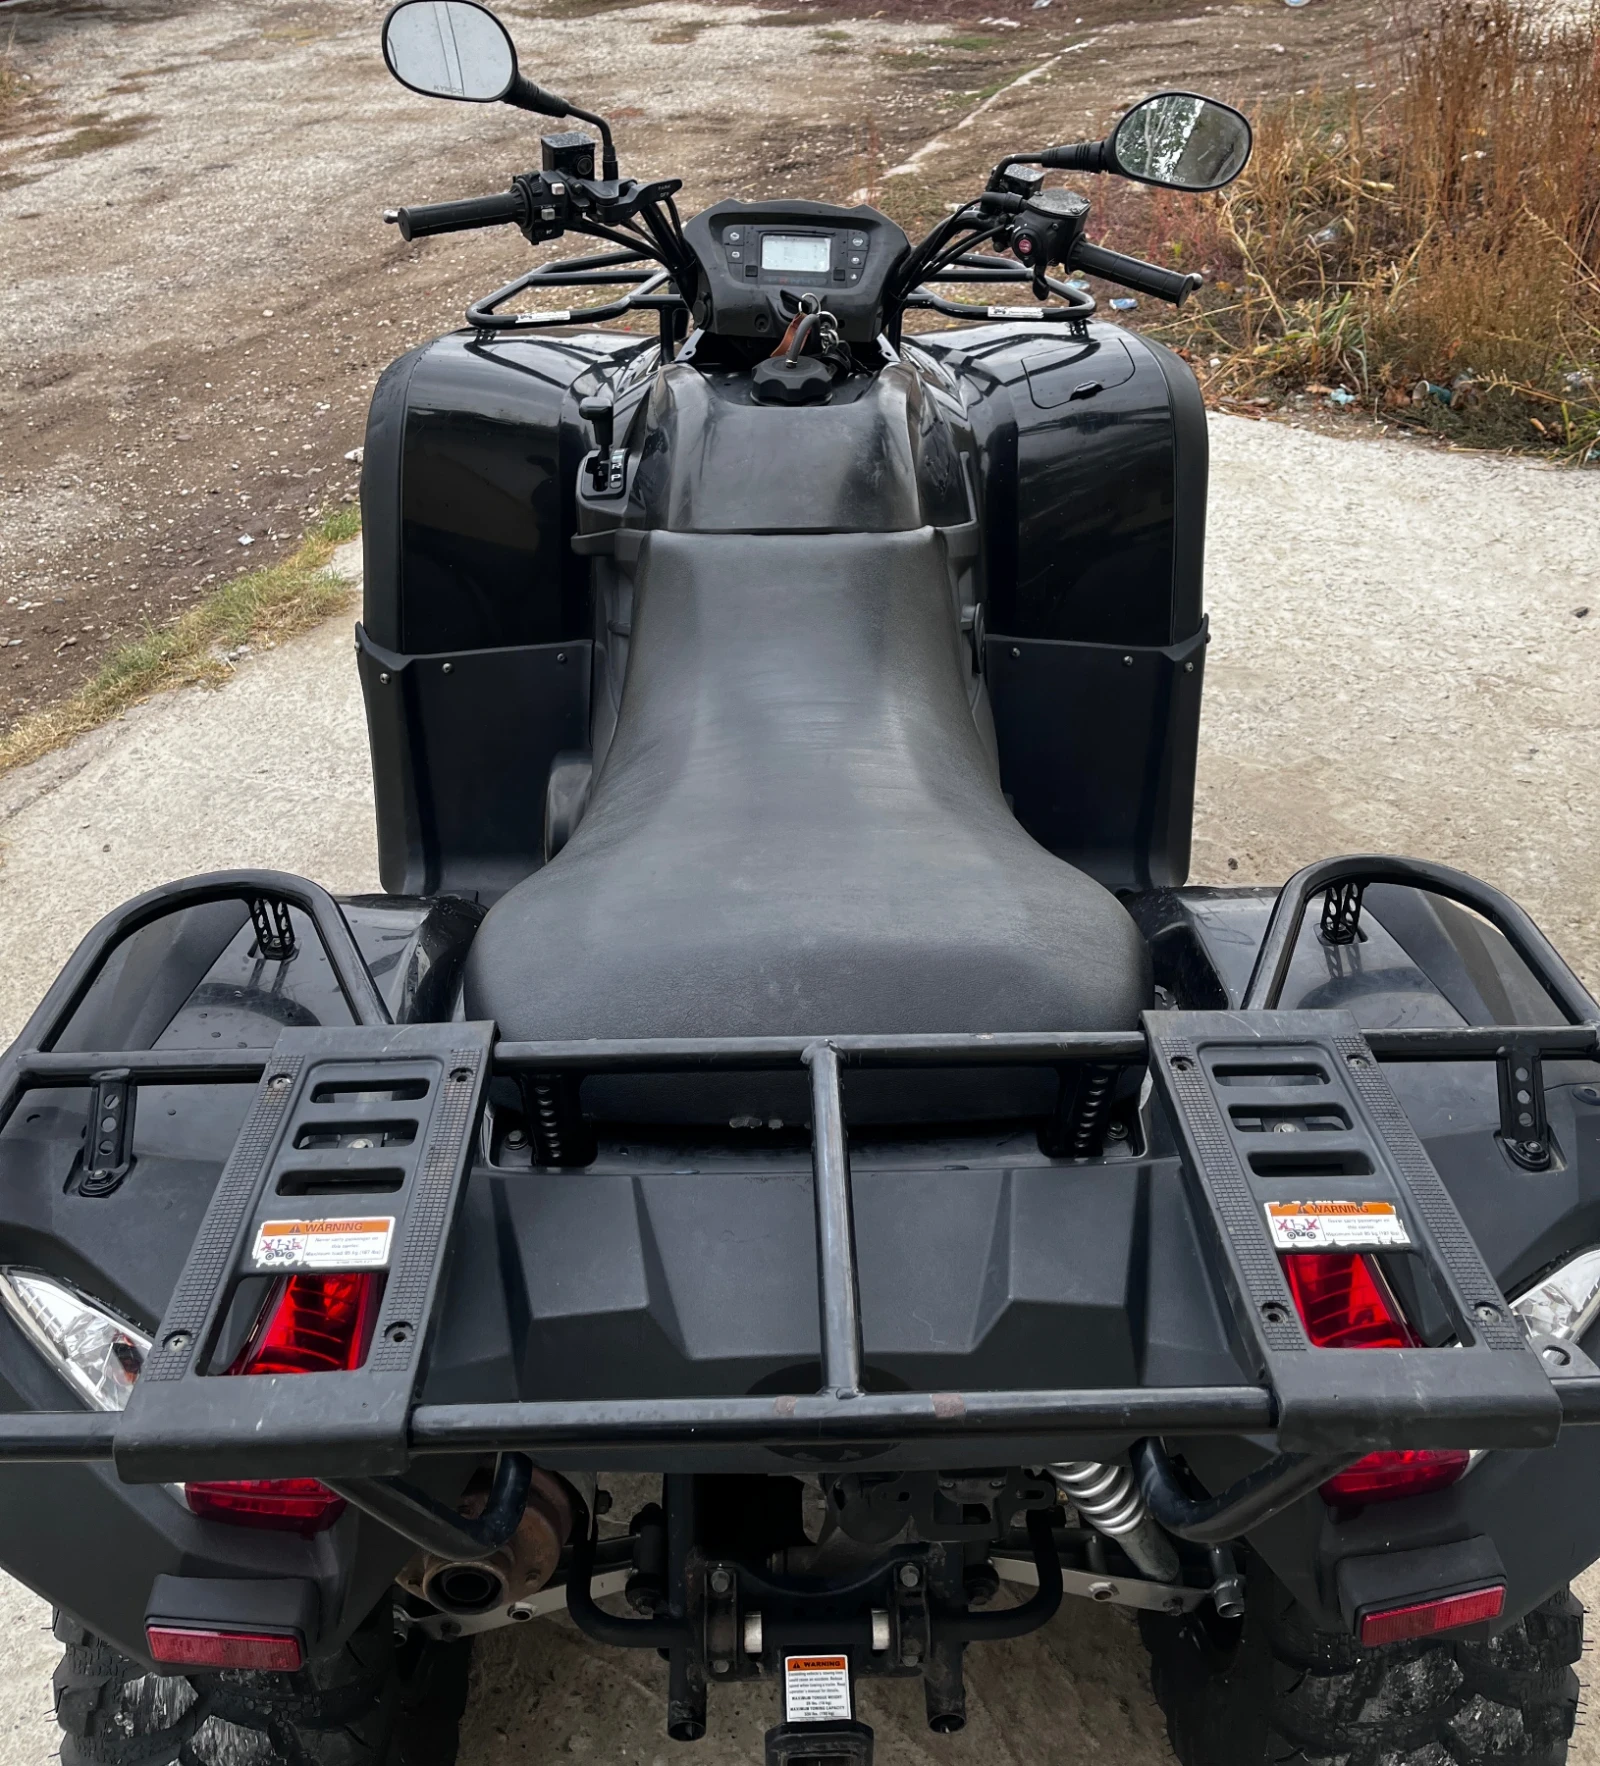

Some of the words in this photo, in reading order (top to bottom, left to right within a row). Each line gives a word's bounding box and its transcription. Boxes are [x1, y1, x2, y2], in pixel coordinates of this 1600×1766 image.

[611, 462, 623, 470] R
[610, 473, 622, 482] P
[1310, 1204, 1369, 1214] WARNING
[305, 1222, 363, 1232] WARNING
[803, 1660, 841, 1668] WARNING
